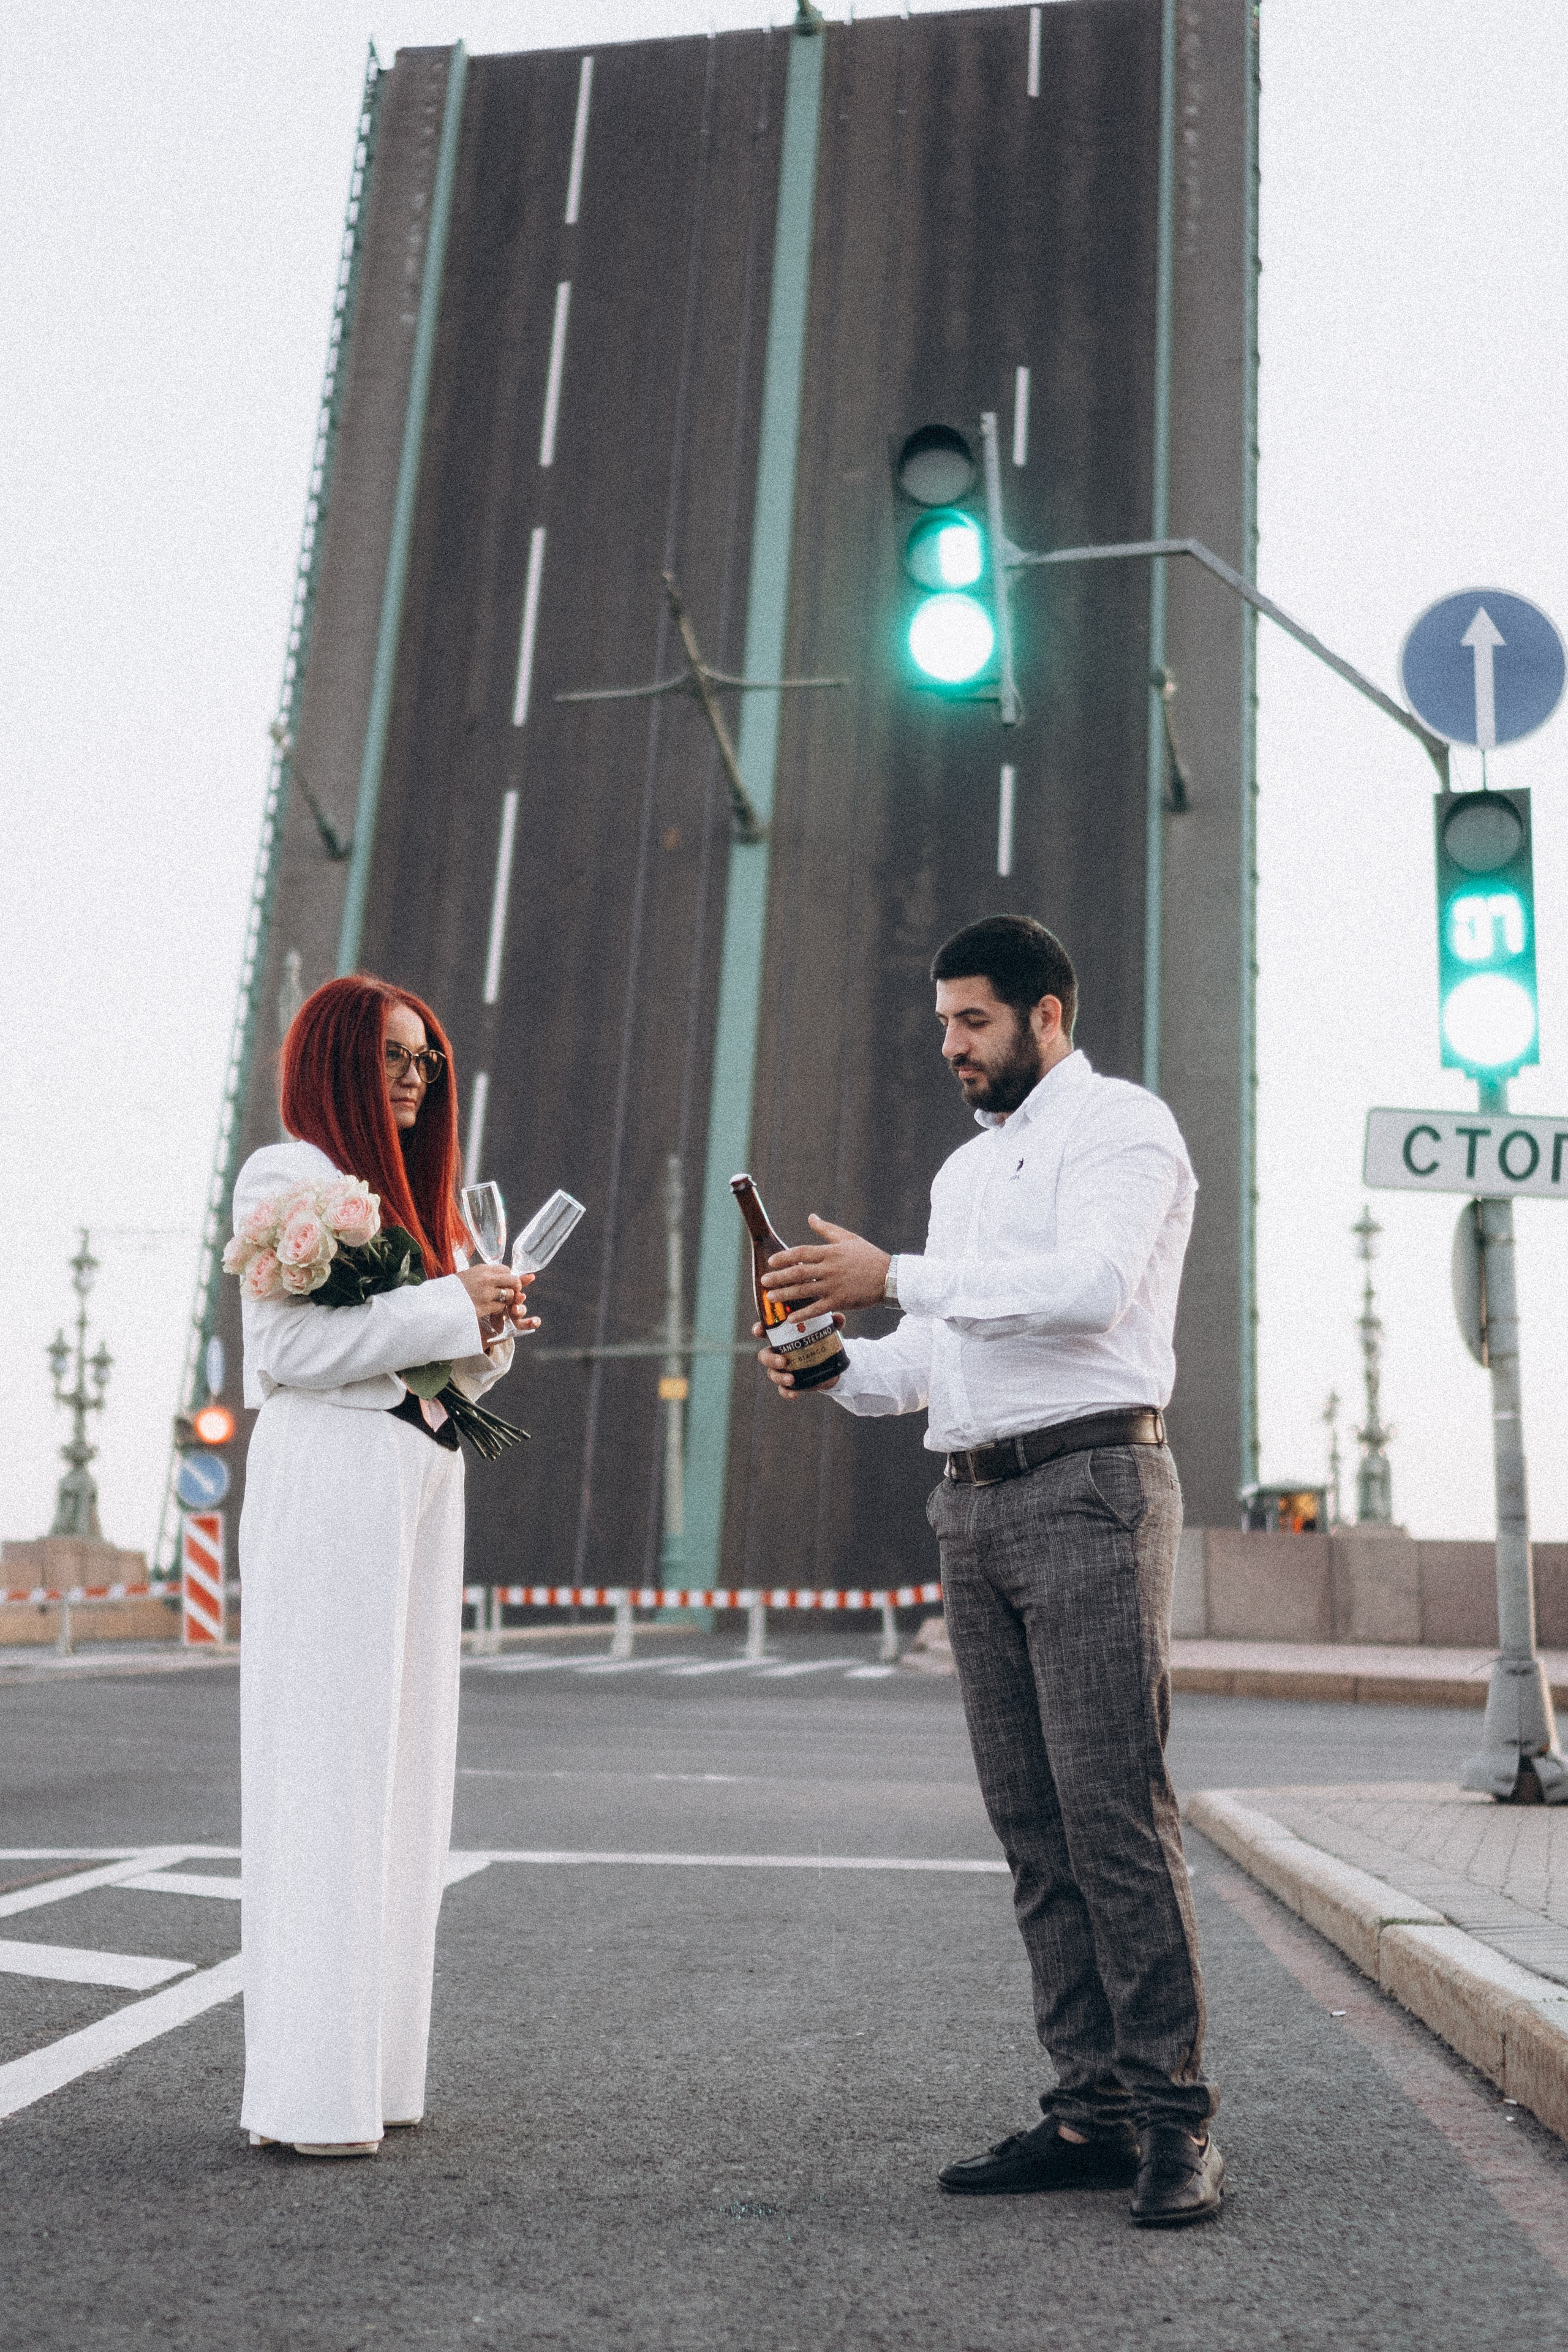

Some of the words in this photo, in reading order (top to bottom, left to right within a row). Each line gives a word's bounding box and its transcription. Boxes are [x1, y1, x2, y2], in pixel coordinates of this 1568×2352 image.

[779, 1341, 801, 1353] SANTO
[803, 1327, 831, 1346] STEFANO
[797, 1346, 826, 1361] BIANCO
